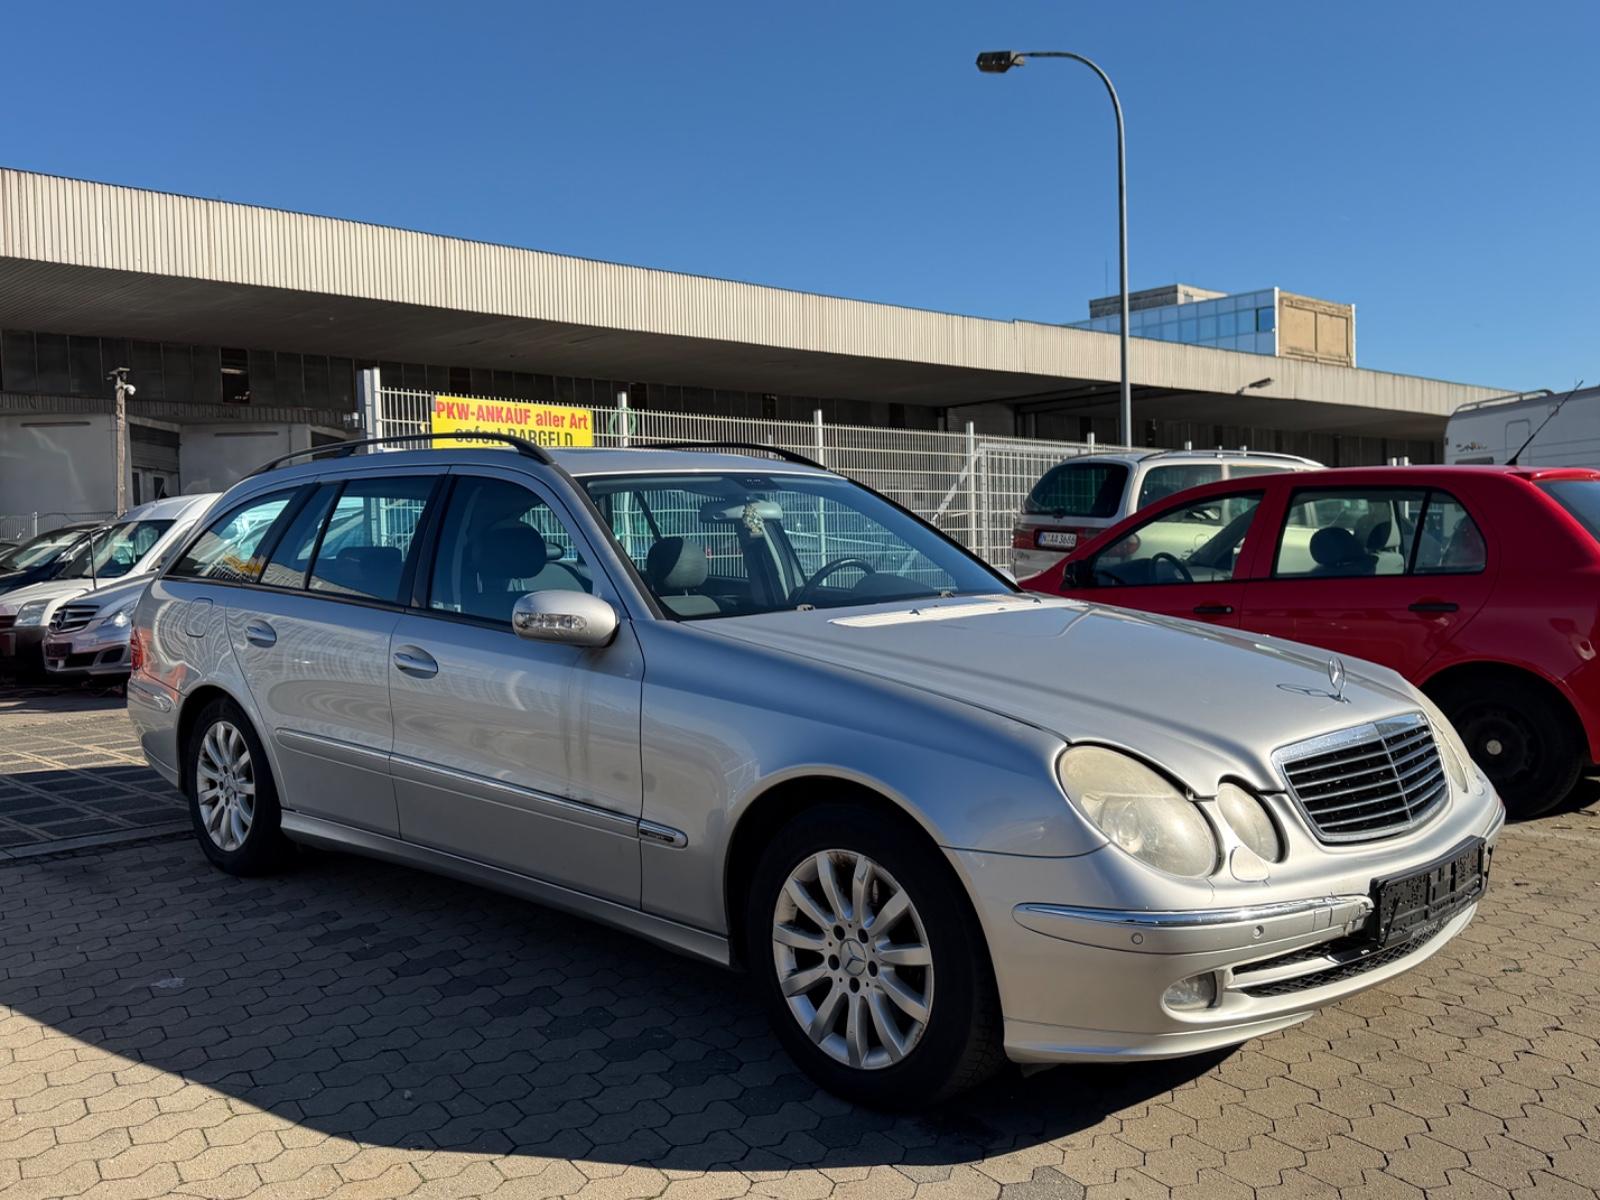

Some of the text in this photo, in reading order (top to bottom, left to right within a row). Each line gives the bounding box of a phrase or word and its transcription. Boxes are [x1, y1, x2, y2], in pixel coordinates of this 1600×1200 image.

[435, 401, 589, 430] PKW-ANKAUF aller Art
